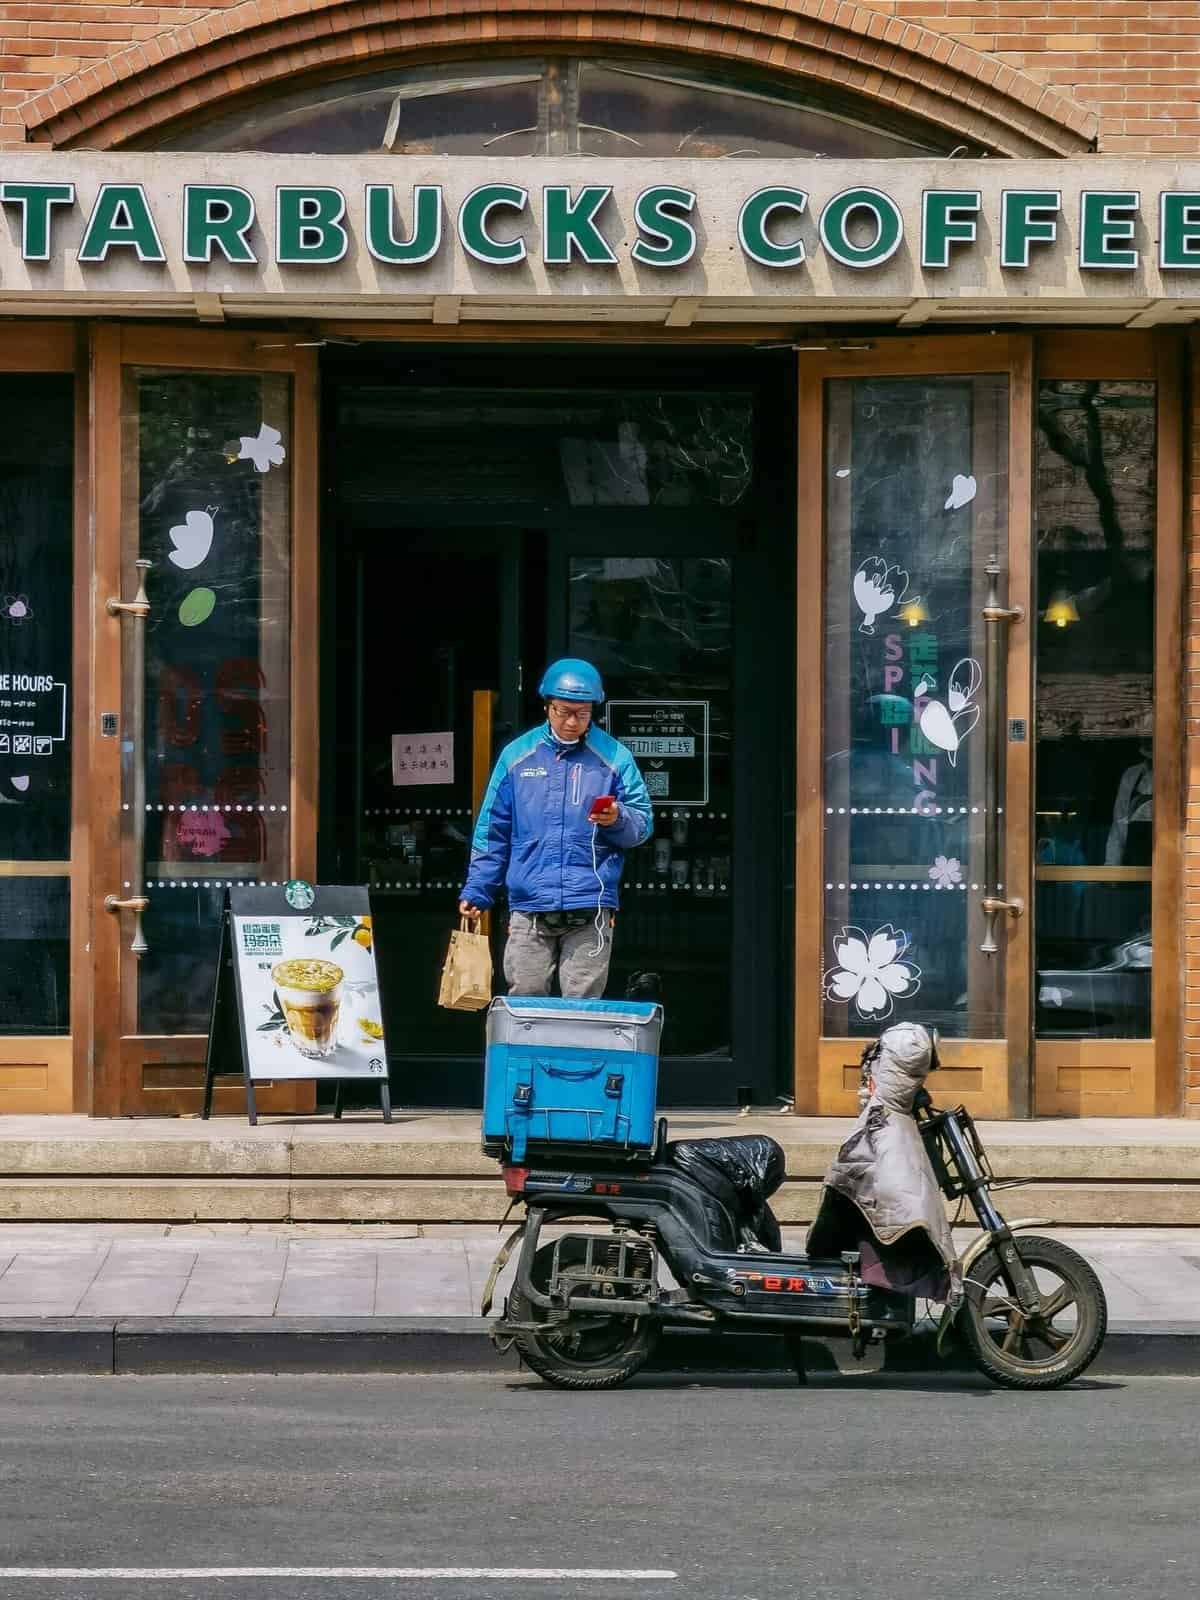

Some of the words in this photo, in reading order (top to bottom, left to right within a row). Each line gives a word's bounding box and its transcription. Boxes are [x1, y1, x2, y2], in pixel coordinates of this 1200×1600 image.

[737, 186, 1200, 271] COFFEE
[12, 674, 54, 692] HOURS
[243, 934, 281, 947] 玛奇朵
[258, 962, 272, 970] NEW
